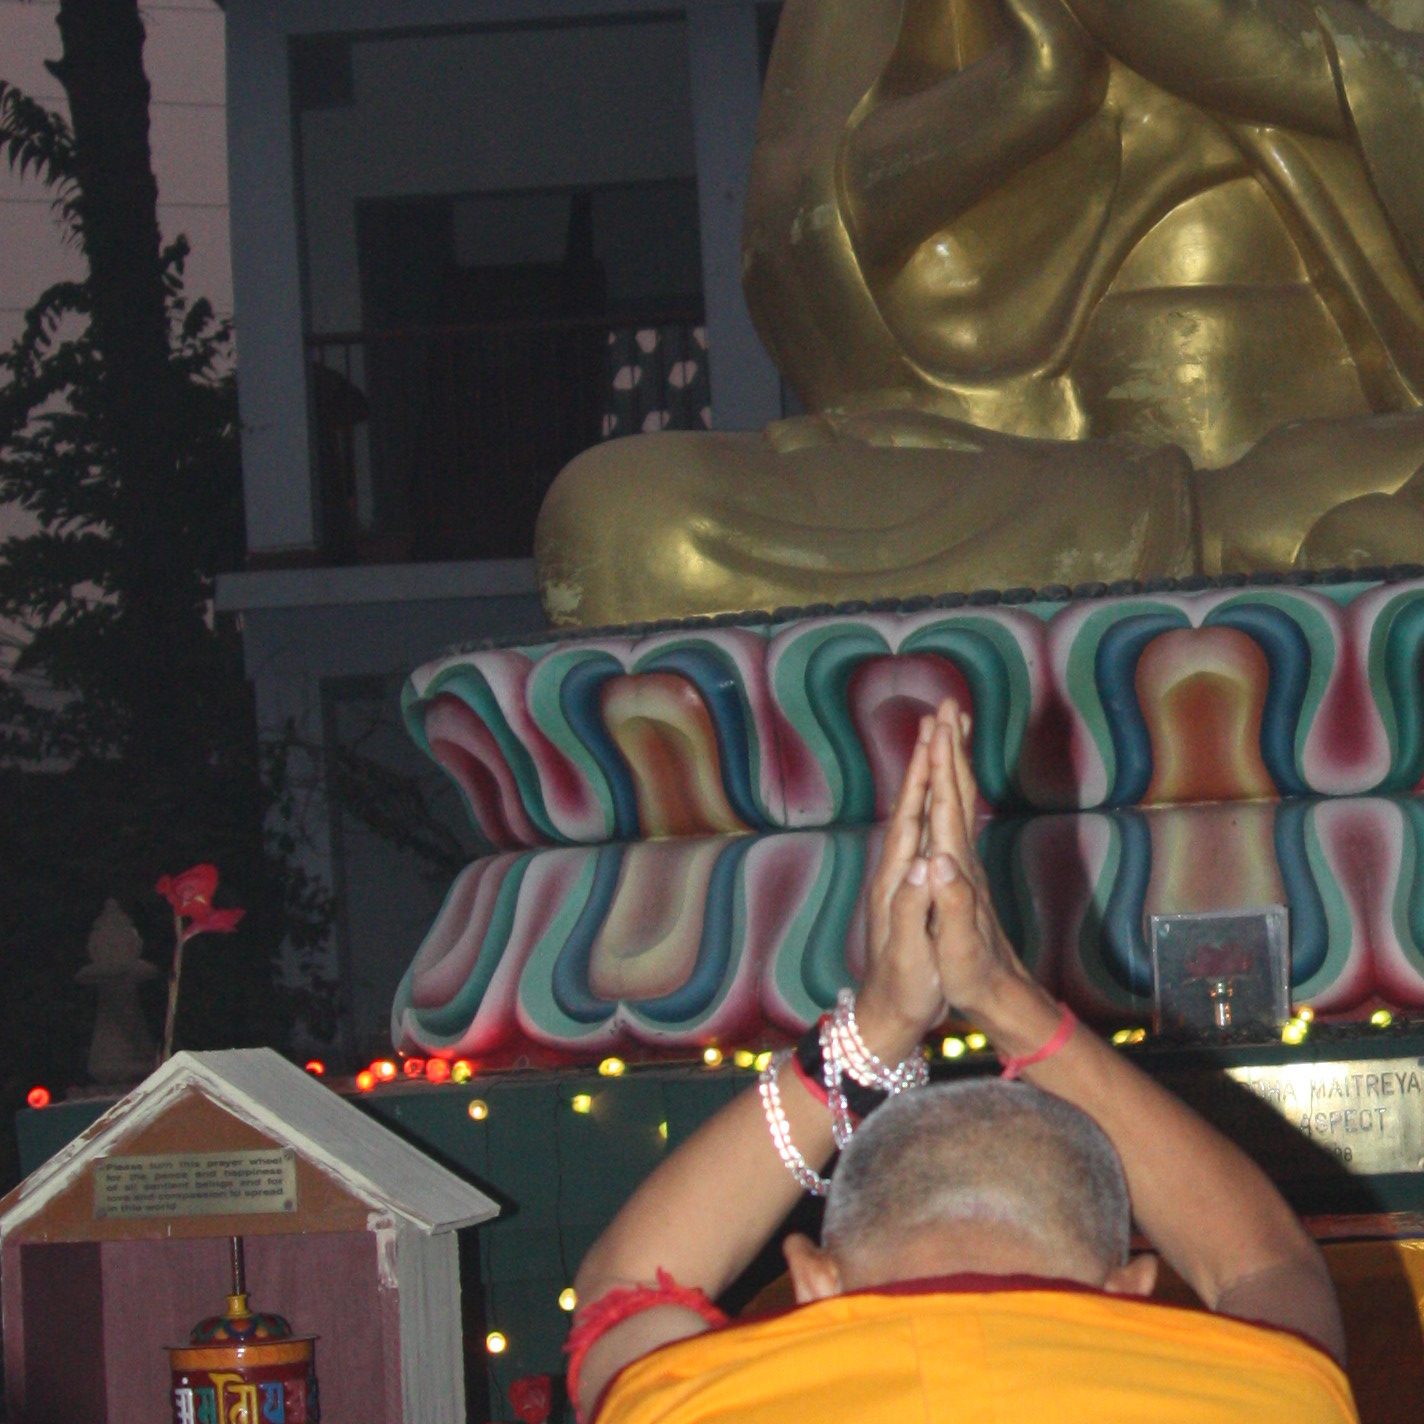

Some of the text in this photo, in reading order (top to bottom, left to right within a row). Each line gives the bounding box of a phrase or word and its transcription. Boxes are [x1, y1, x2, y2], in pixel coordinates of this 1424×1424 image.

[1311, 1071, 1421, 1099] MAITREYA
[105, 1162, 143, 1171] Please
[207, 1159, 244, 1168] prayer
[248, 1156, 282, 1166] wheel
[195, 1170, 217, 1178] and
[224, 1167, 282, 1178] happiness
[195, 1180, 233, 1189] beings
[240, 1178, 261, 1186] and
[267, 1177, 282, 1186] for
[158, 1191, 227, 1201] compassion
[244, 1187, 284, 1198] spread
